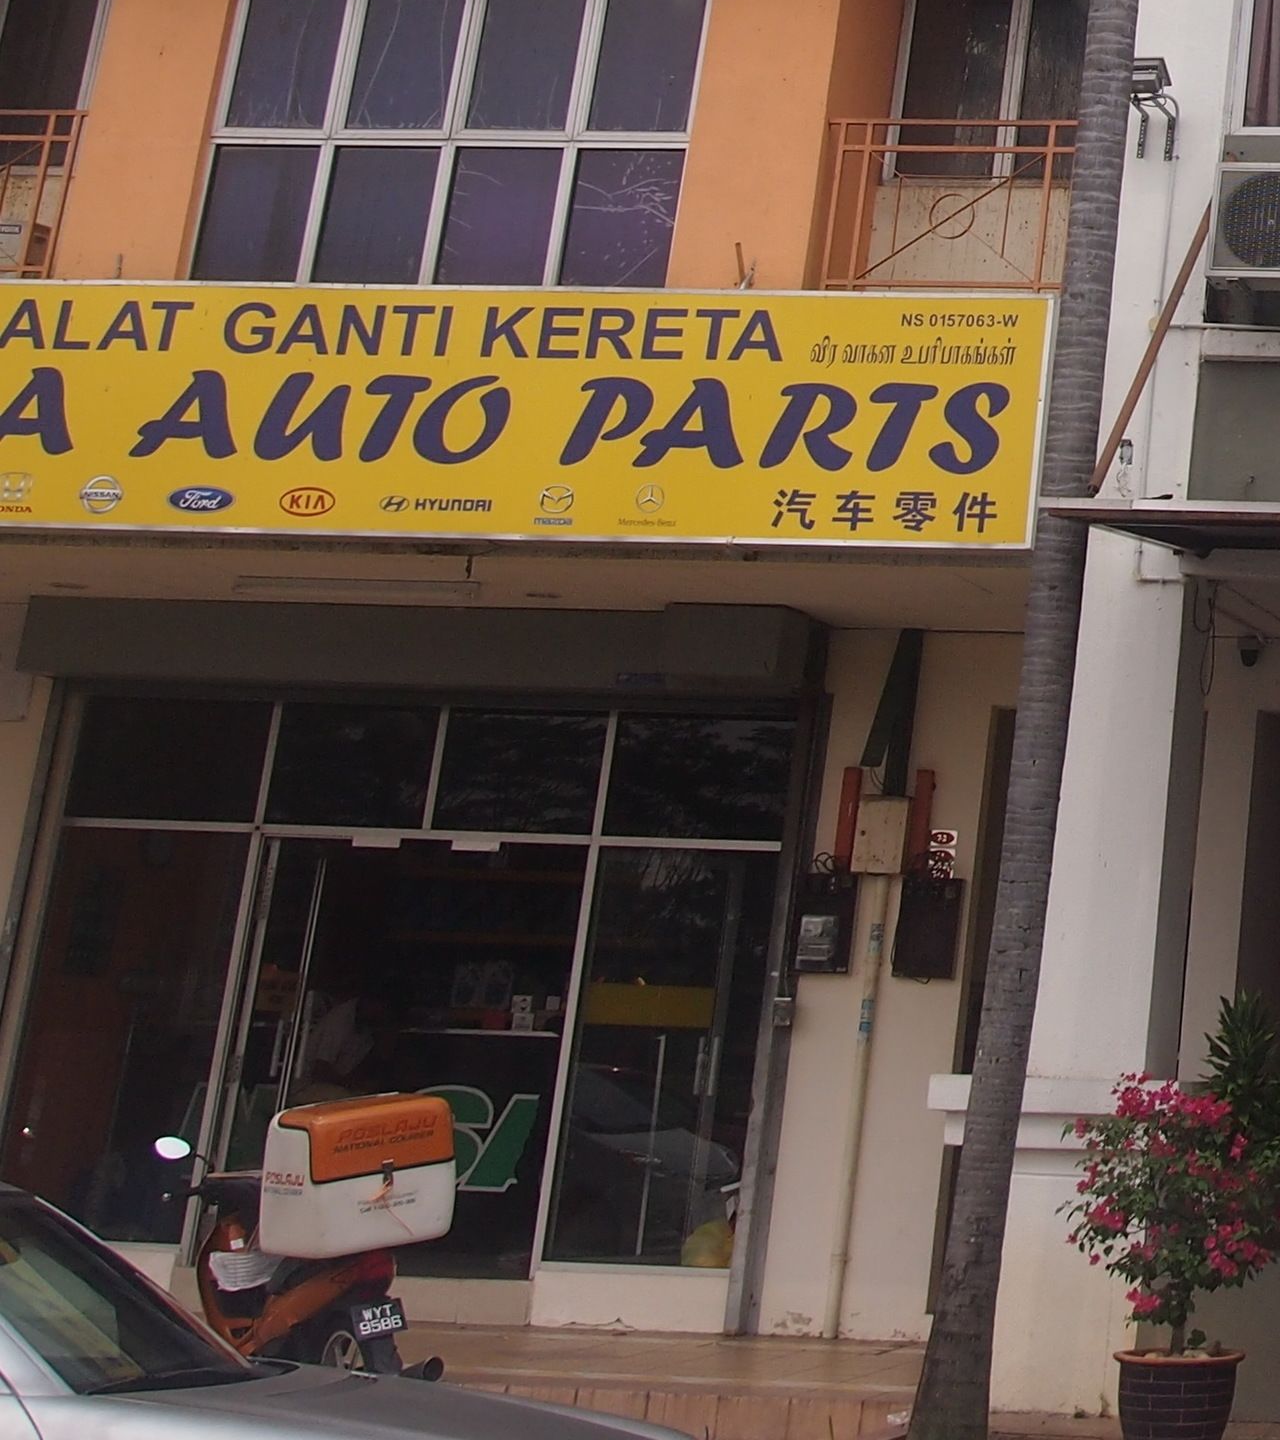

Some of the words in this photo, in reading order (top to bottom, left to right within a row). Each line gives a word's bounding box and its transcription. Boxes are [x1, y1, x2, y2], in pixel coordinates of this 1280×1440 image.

[0, 299, 195, 352] ALAT
[223, 302, 454, 357] GANTI
[480, 306, 784, 361] KERETA
[901, 314, 925, 327] NS
[929, 314, 1019, 328] 0157063-W
[0, 367, 75, 456] A
[128, 369, 512, 465] AUTO
[559, 377, 1011, 475] PARTS
[83, 490, 122, 500] NISSAN
[179, 488, 222, 509] Ford
[289, 494, 326, 510] KIA
[414, 498, 492, 512] HYUNDAI
[771, 489, 998, 533] 汽车零件
[338, 1115, 439, 1144] POSLAJU
[333, 1137, 385, 1155] NATIONAL
[362, 1303, 393, 1321] WYT
[359, 1314, 403, 1336] 9586
